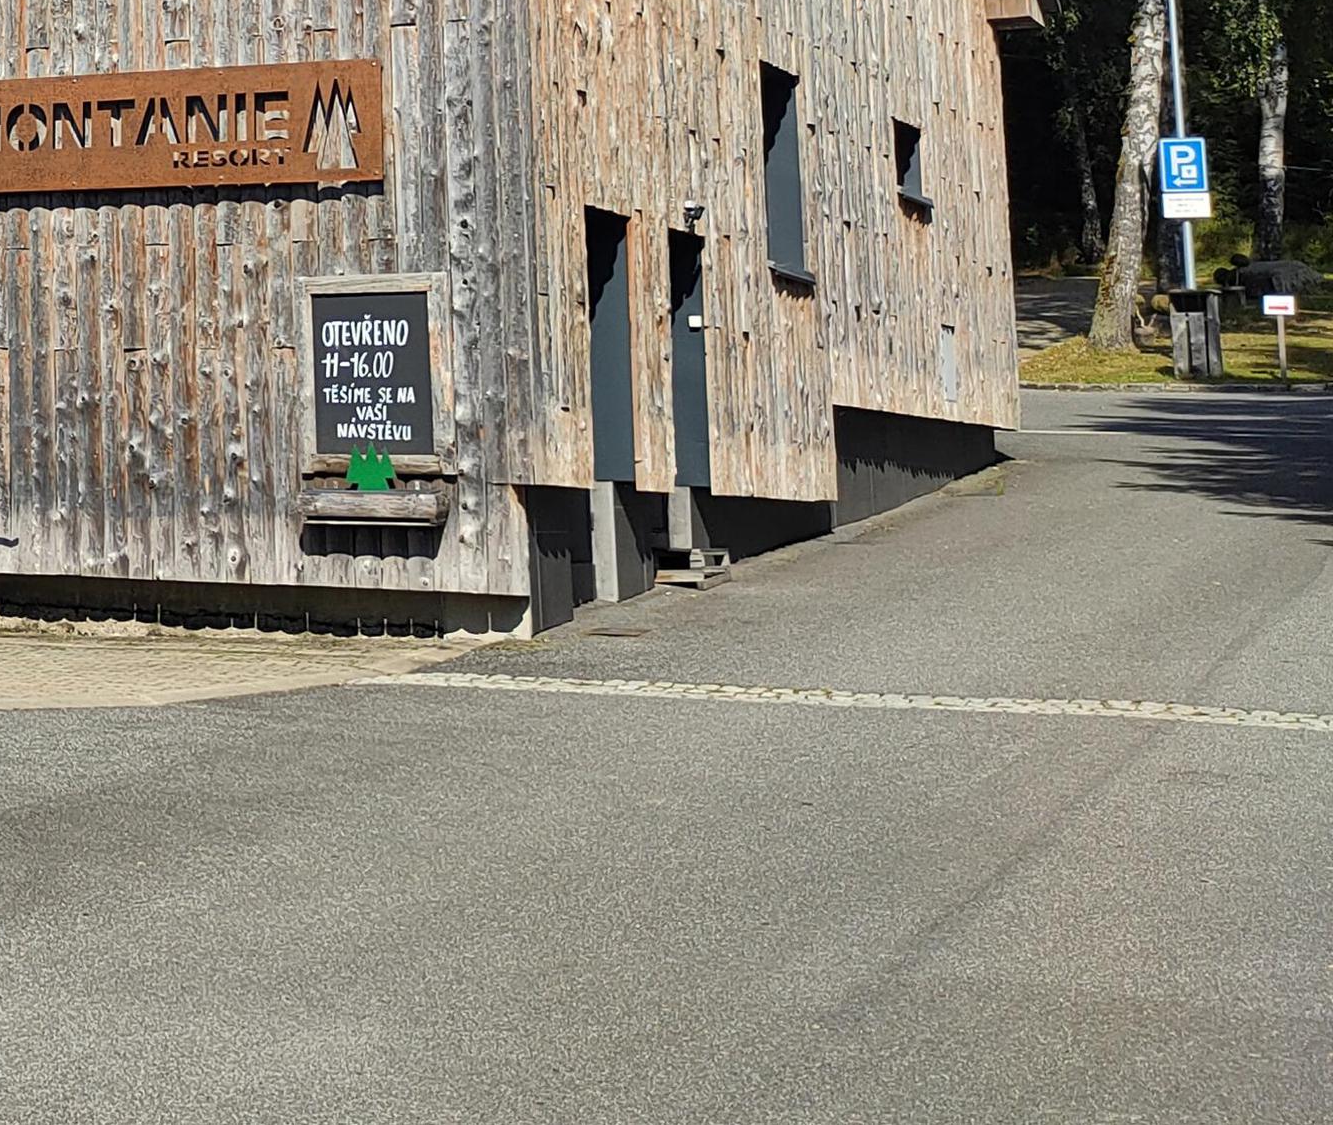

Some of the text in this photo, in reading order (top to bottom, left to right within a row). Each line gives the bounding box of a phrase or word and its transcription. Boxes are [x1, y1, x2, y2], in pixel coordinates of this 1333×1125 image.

[172, 146, 291, 169] RESORT
[1169, 145, 1196, 176] P
[322, 314, 409, 347] OTEVŘENO
[321, 351, 394, 378] 11-16.00
[322, 382, 416, 403] TĚŠÍME SE NA
[356, 403, 387, 421] VAŠI
